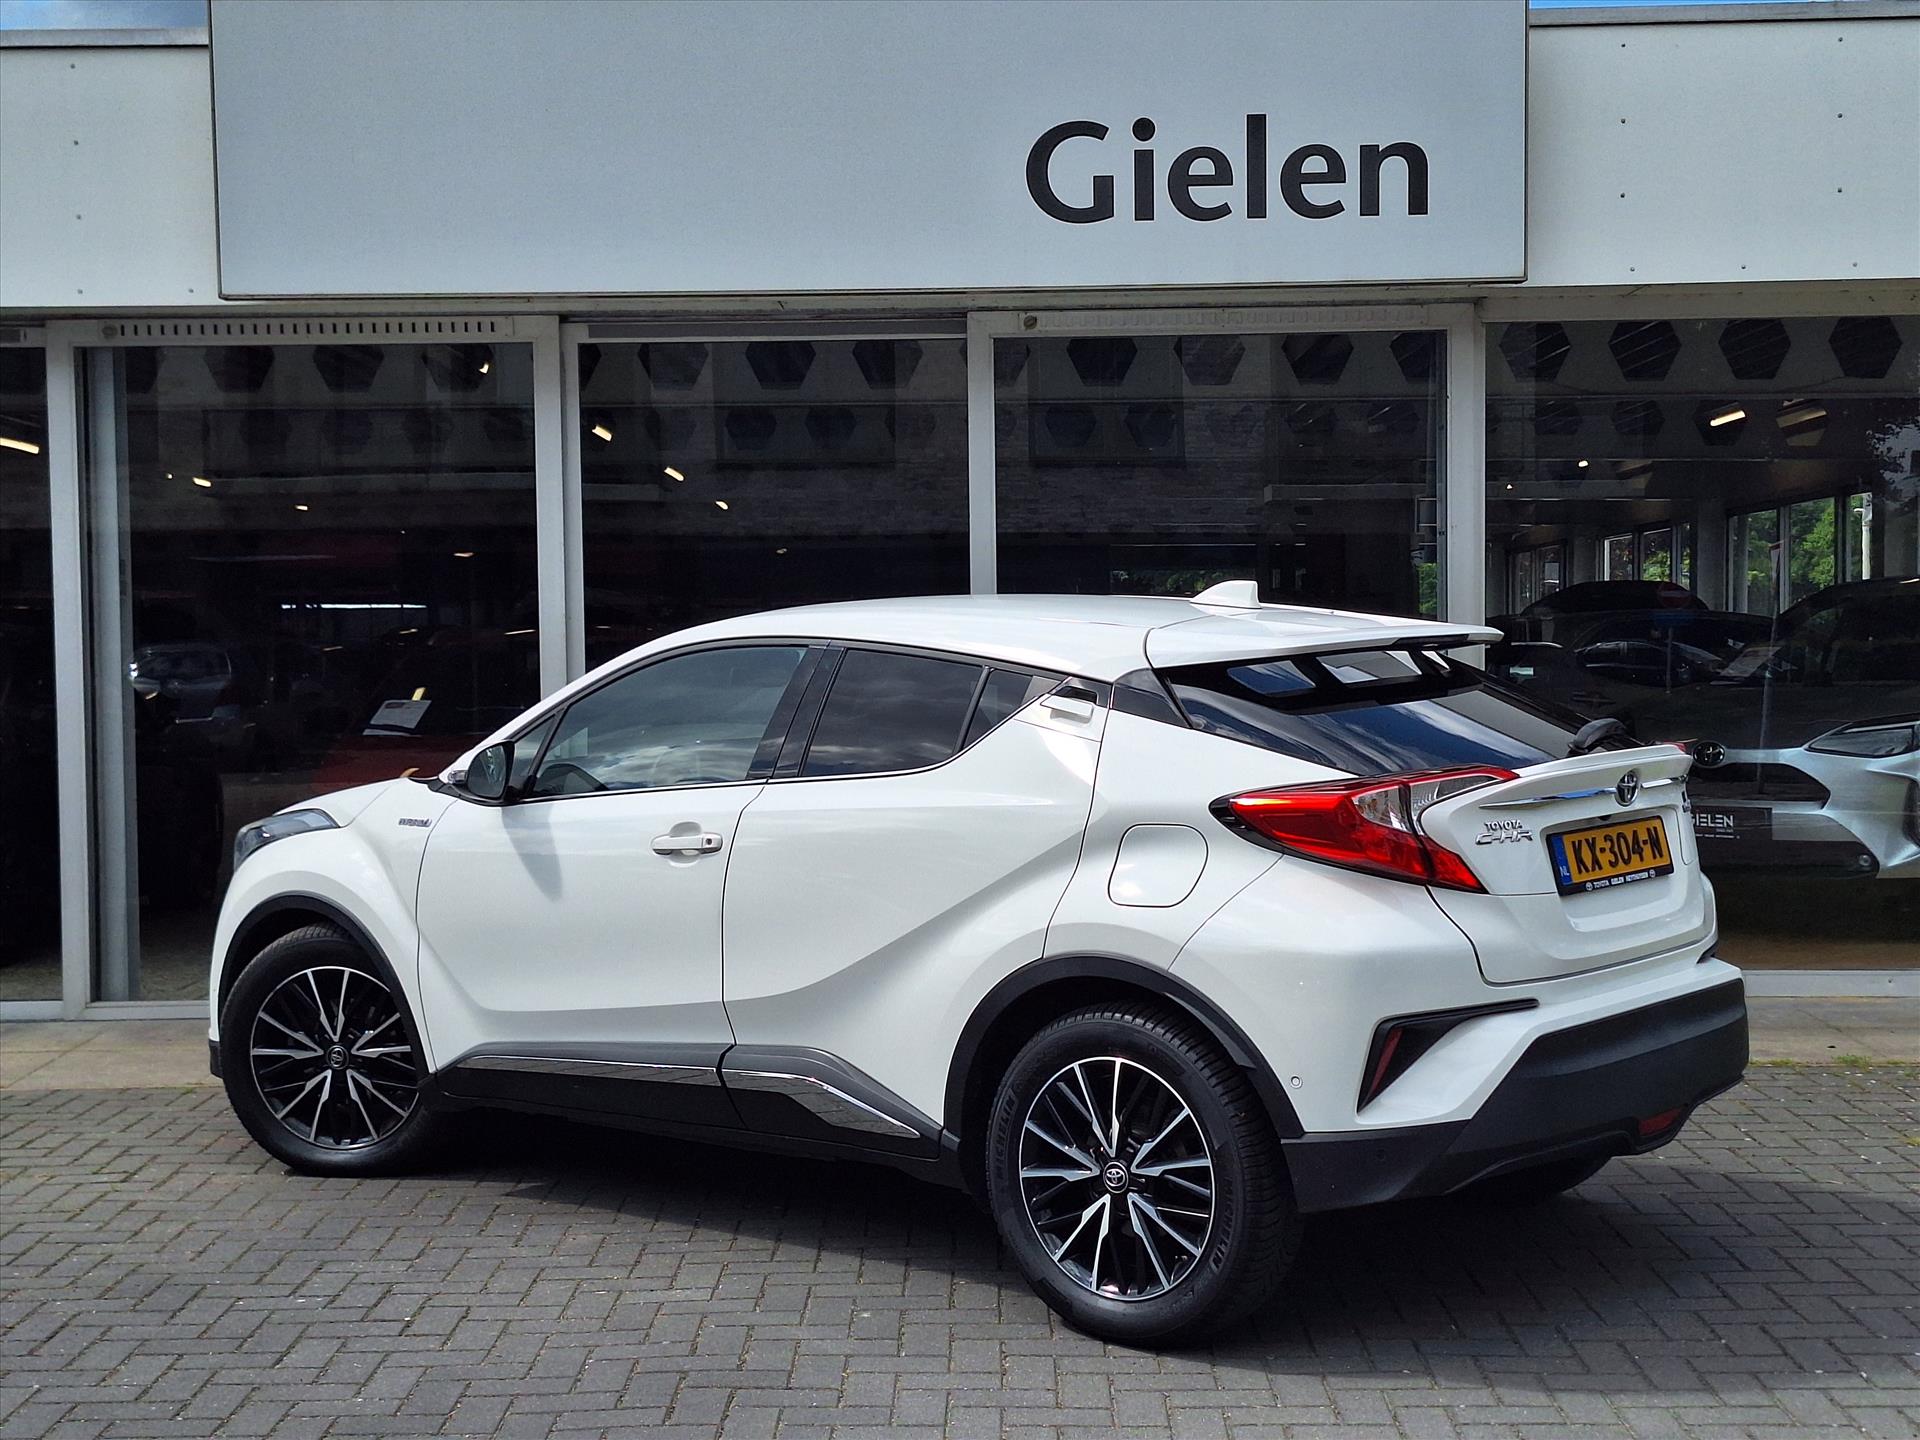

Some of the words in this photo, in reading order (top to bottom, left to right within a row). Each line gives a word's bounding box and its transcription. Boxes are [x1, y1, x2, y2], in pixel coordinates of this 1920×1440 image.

[1026, 113, 1429, 224] Gielen
[1485, 819, 1522, 832] TOYOTA
[1475, 830, 1533, 845] C-HR
[1571, 826, 1664, 875] KX-304-N
[1559, 865, 1570, 877] NL
